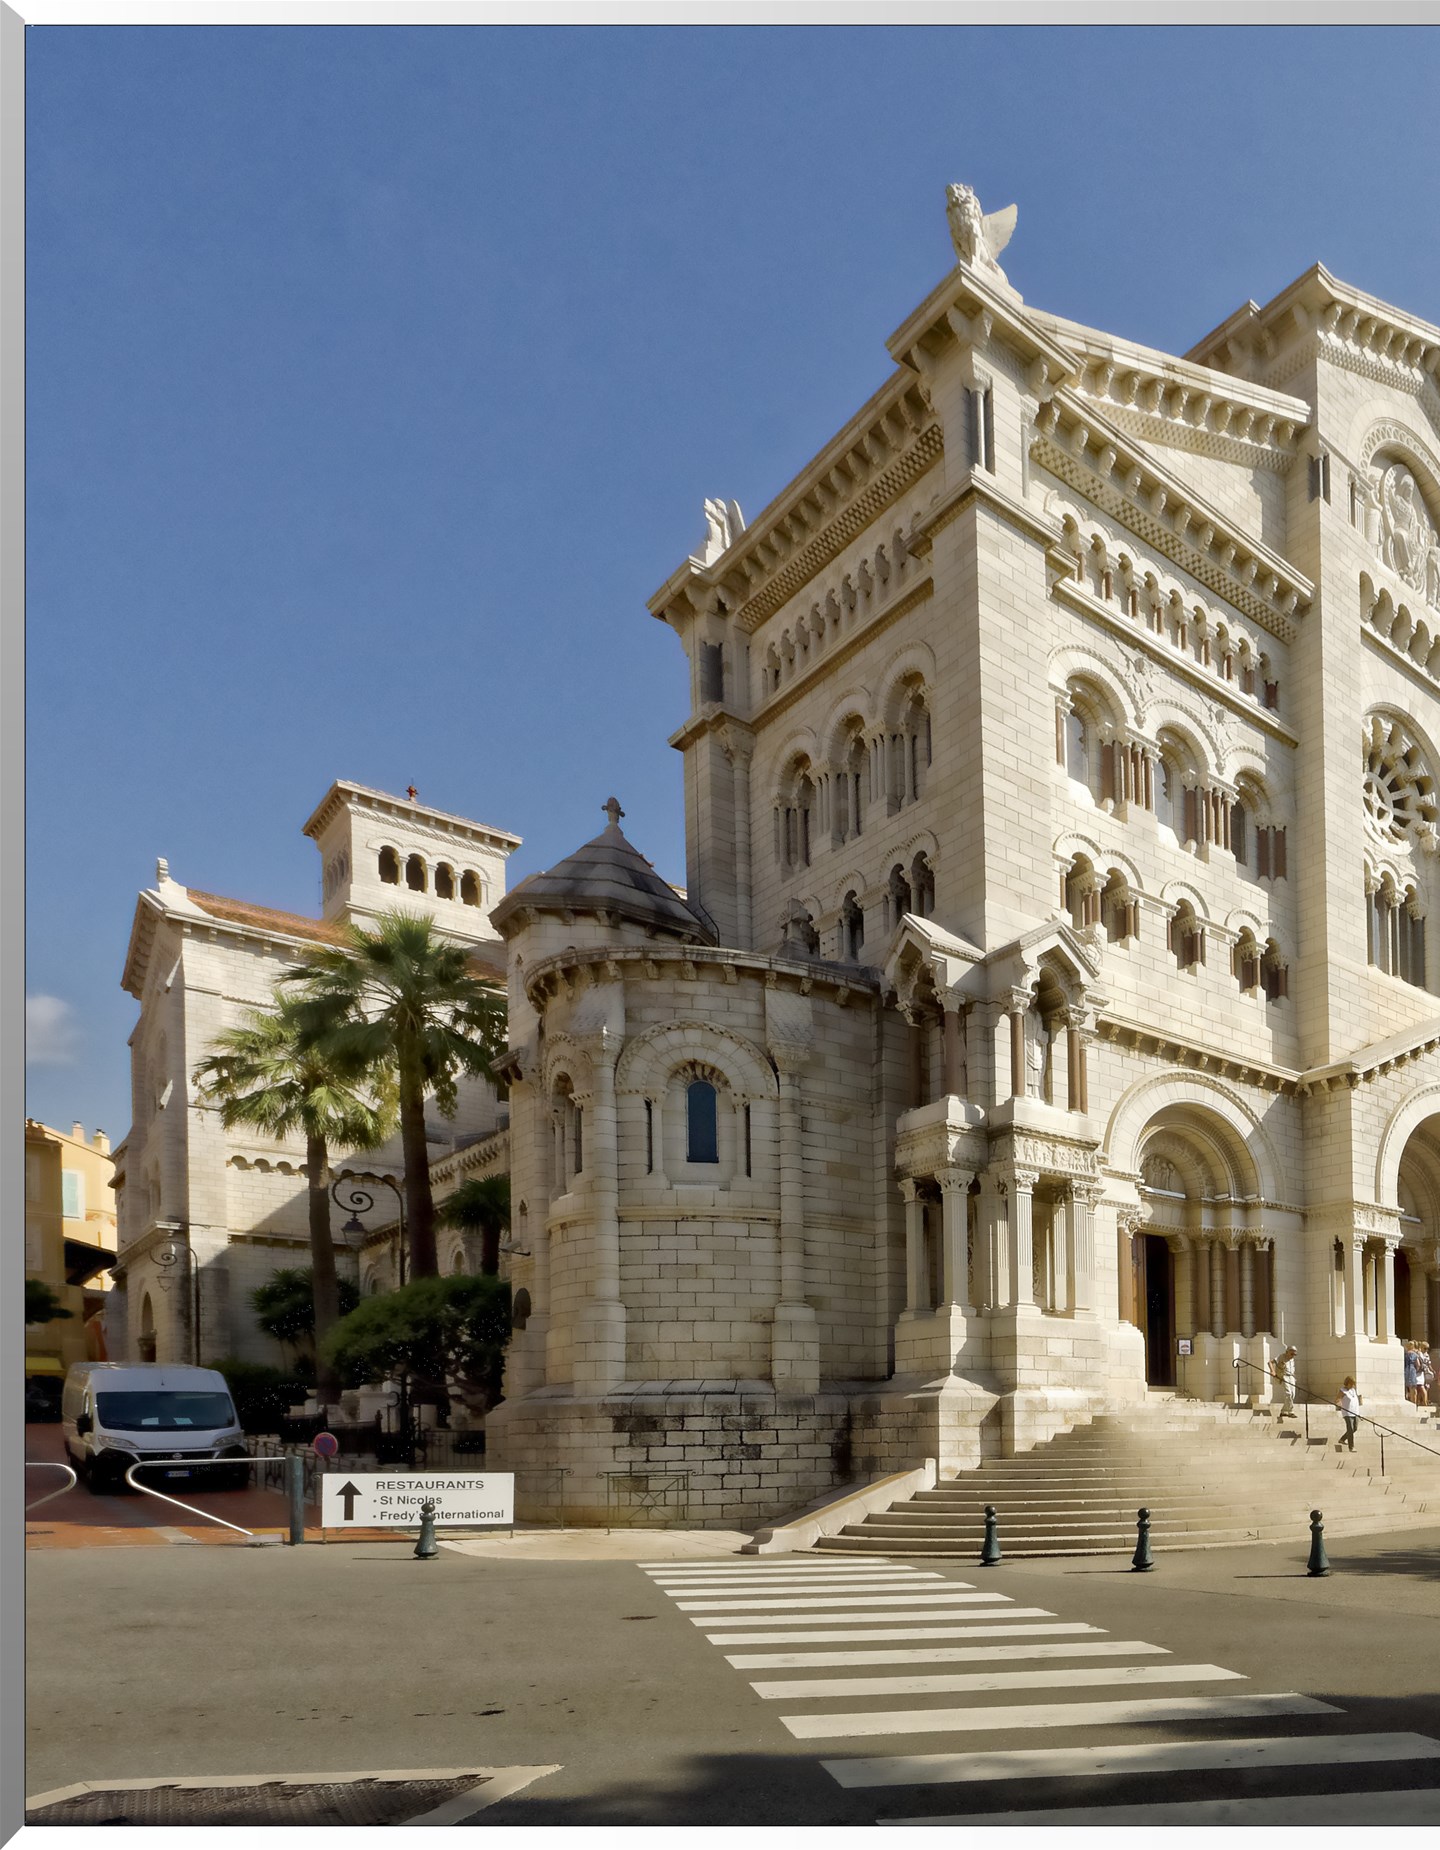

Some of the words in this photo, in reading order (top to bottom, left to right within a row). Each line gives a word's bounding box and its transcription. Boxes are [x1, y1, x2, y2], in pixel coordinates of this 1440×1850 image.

[376, 1480, 484, 1490] RESTAURANTS
[380, 1495, 393, 1505] St
[397, 1495, 443, 1505] Nicolas
[431, 1509, 504, 1520] nternational
